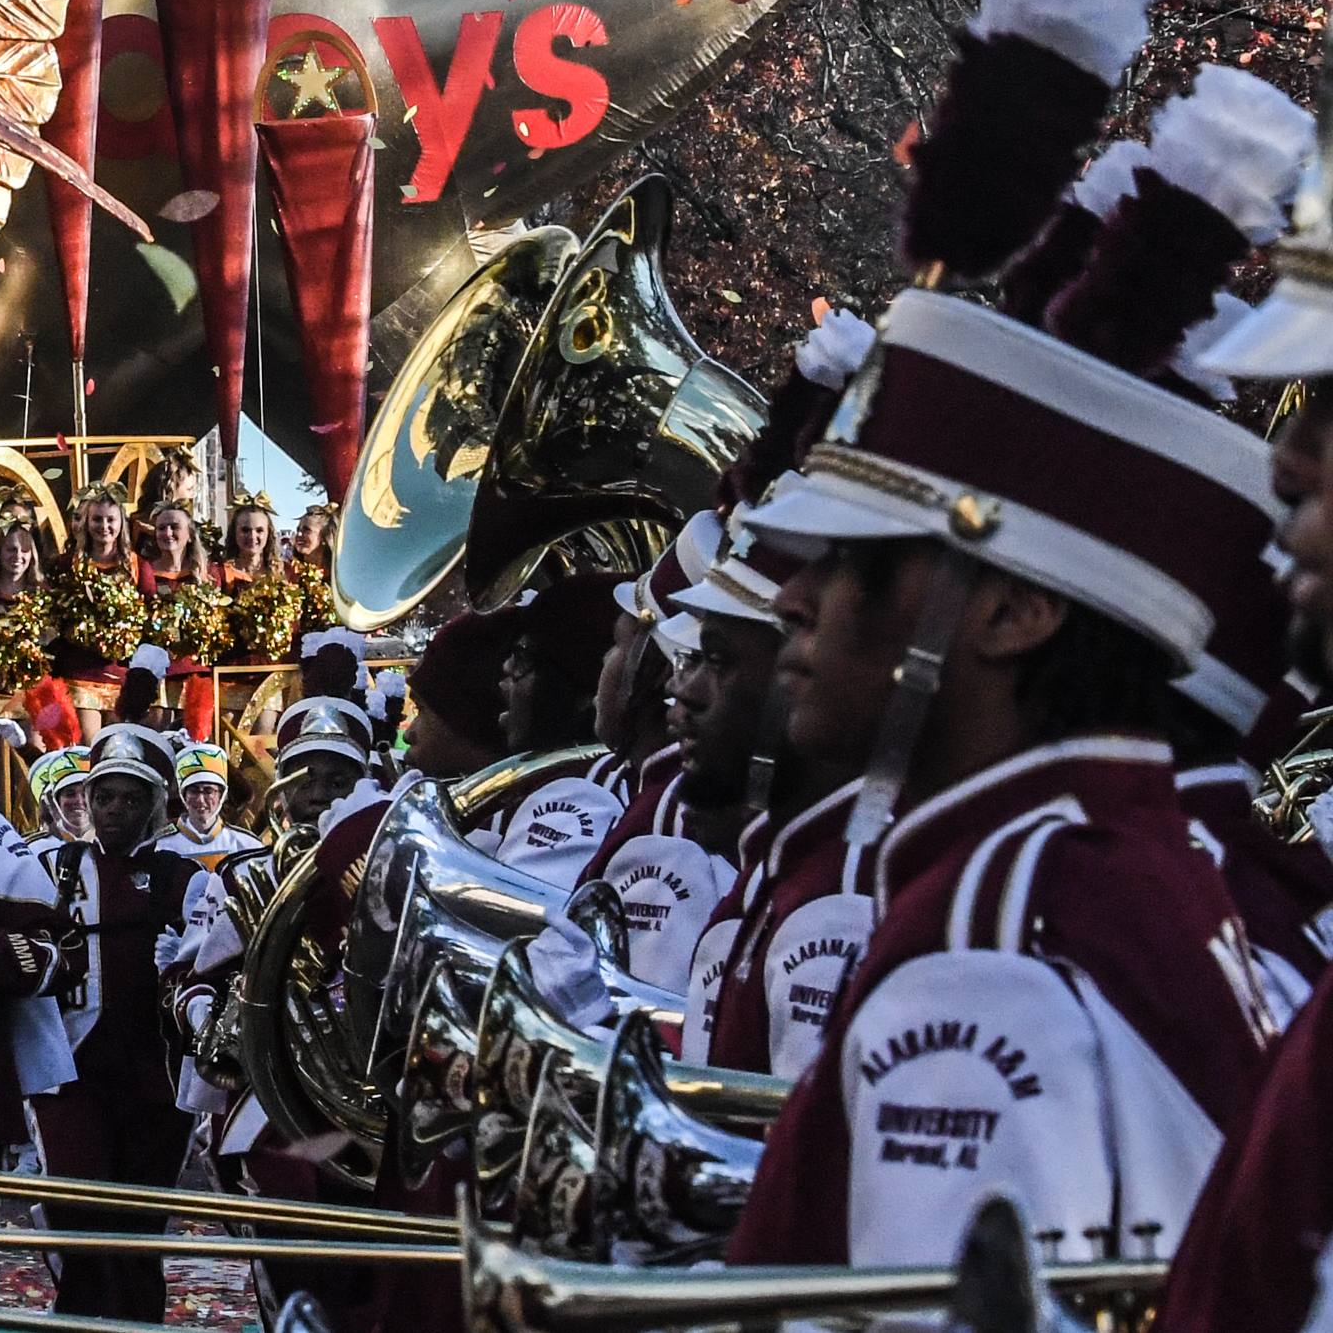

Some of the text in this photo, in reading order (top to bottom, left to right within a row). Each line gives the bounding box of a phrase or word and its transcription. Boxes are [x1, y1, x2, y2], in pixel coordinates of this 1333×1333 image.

[620, 865, 690, 901] ALABAMA A&M
[7, 933, 38, 973] MMW
[861, 1020, 1043, 1100] ALABAMA A&M
